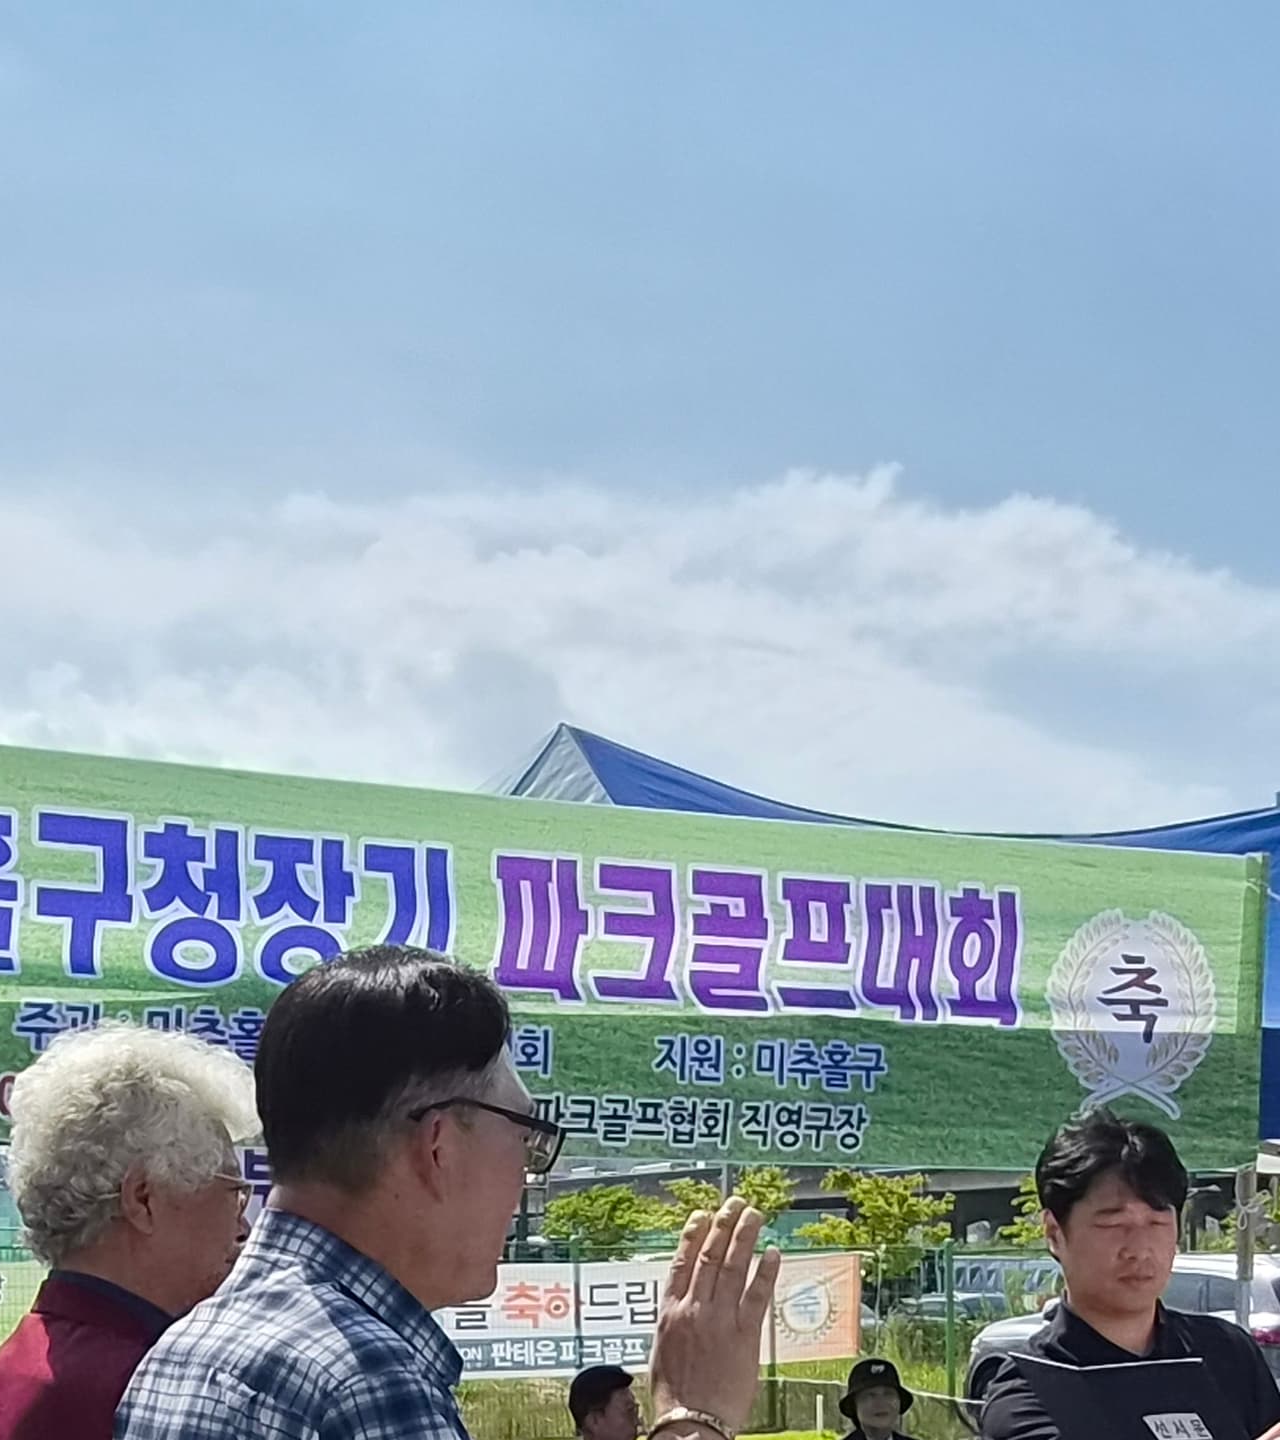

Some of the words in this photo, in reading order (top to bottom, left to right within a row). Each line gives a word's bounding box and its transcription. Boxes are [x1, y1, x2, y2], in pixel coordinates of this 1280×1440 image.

[492, 853, 1022, 1027] 파크골프대회
[1096, 953, 1169, 1044] 축
[653, 1035, 722, 1083] 지원
[756, 1041, 886, 1091] 미추홀구
[741, 1102, 868, 1151] 직영구장
[501, 1279, 658, 1329] 축하드립
